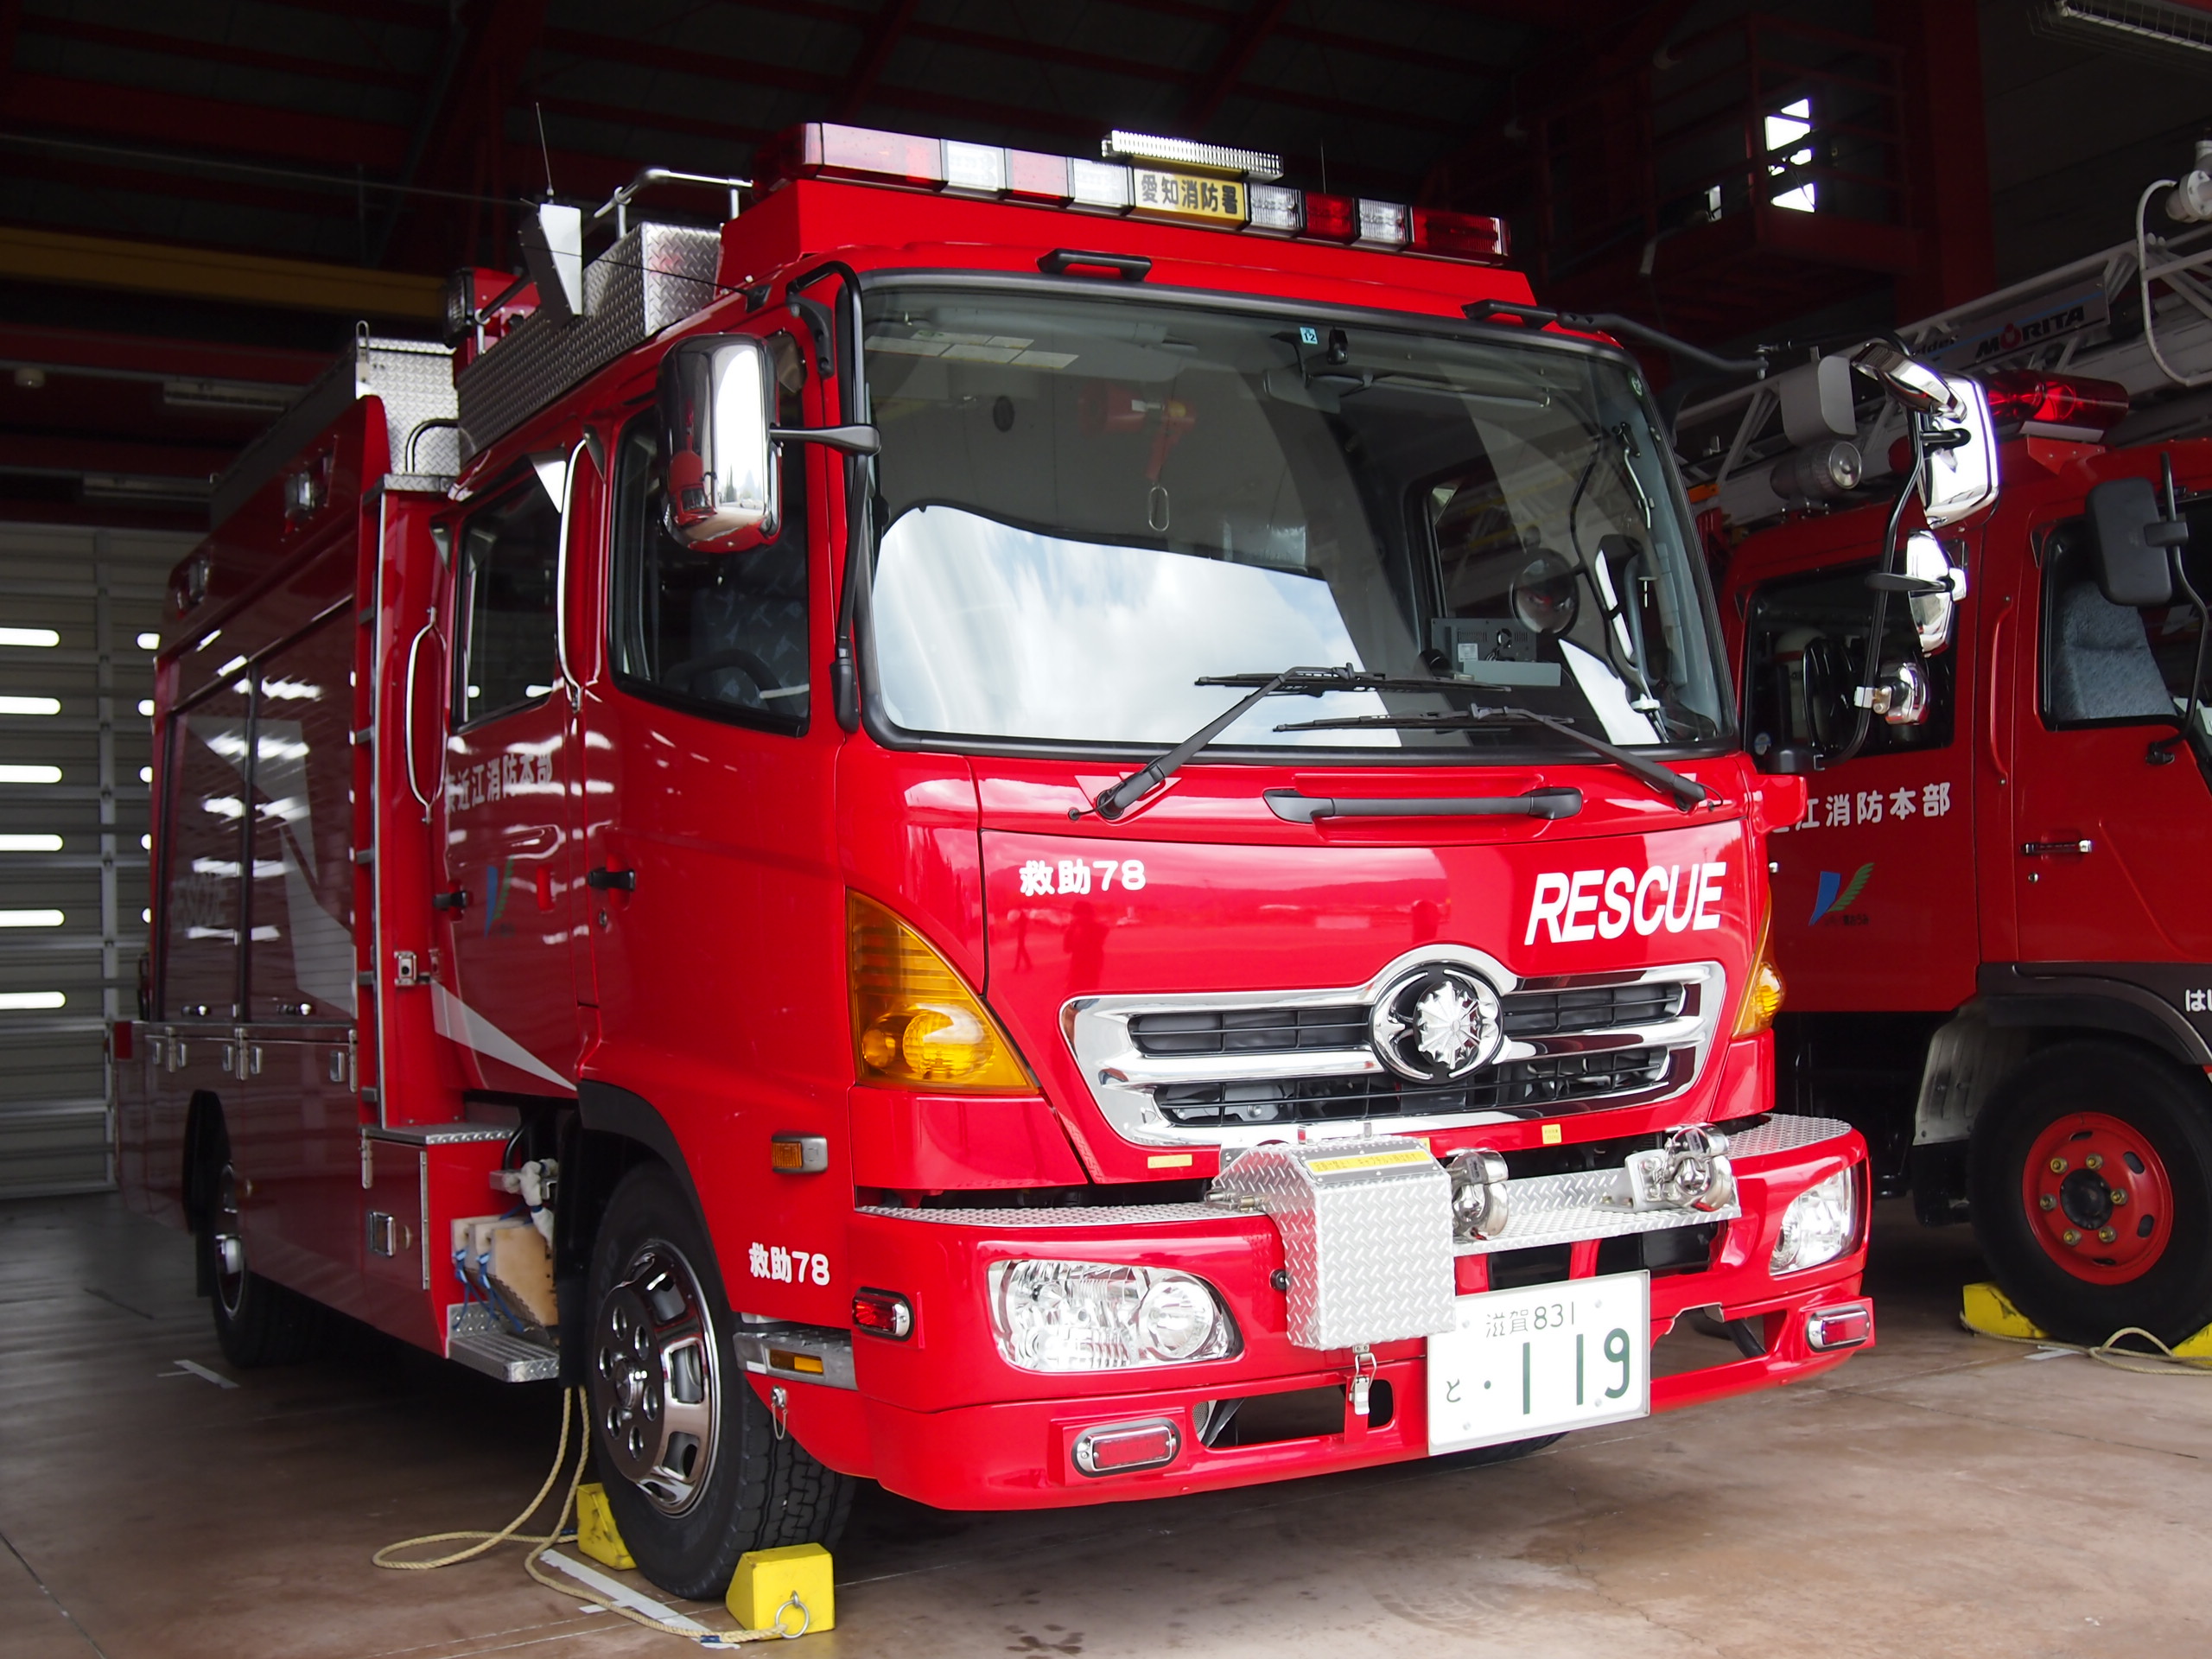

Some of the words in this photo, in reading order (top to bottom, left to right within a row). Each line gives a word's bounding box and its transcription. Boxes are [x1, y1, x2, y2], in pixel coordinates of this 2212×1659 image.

[1141, 174, 1238, 214] 愛知消防署
[1304, 333, 1317, 342] 12
[1975, 306, 2085, 359] MORITA
[1772, 782, 1951, 833] 江消防本部
[1019, 858, 1147, 897] 救助78
[1523, 861, 1726, 946] RESCUE
[748, 1242, 830, 1286] 救助78
[1485, 1301, 1575, 1338] 滋賀831
[1446, 1378, 1462, 1403] と
